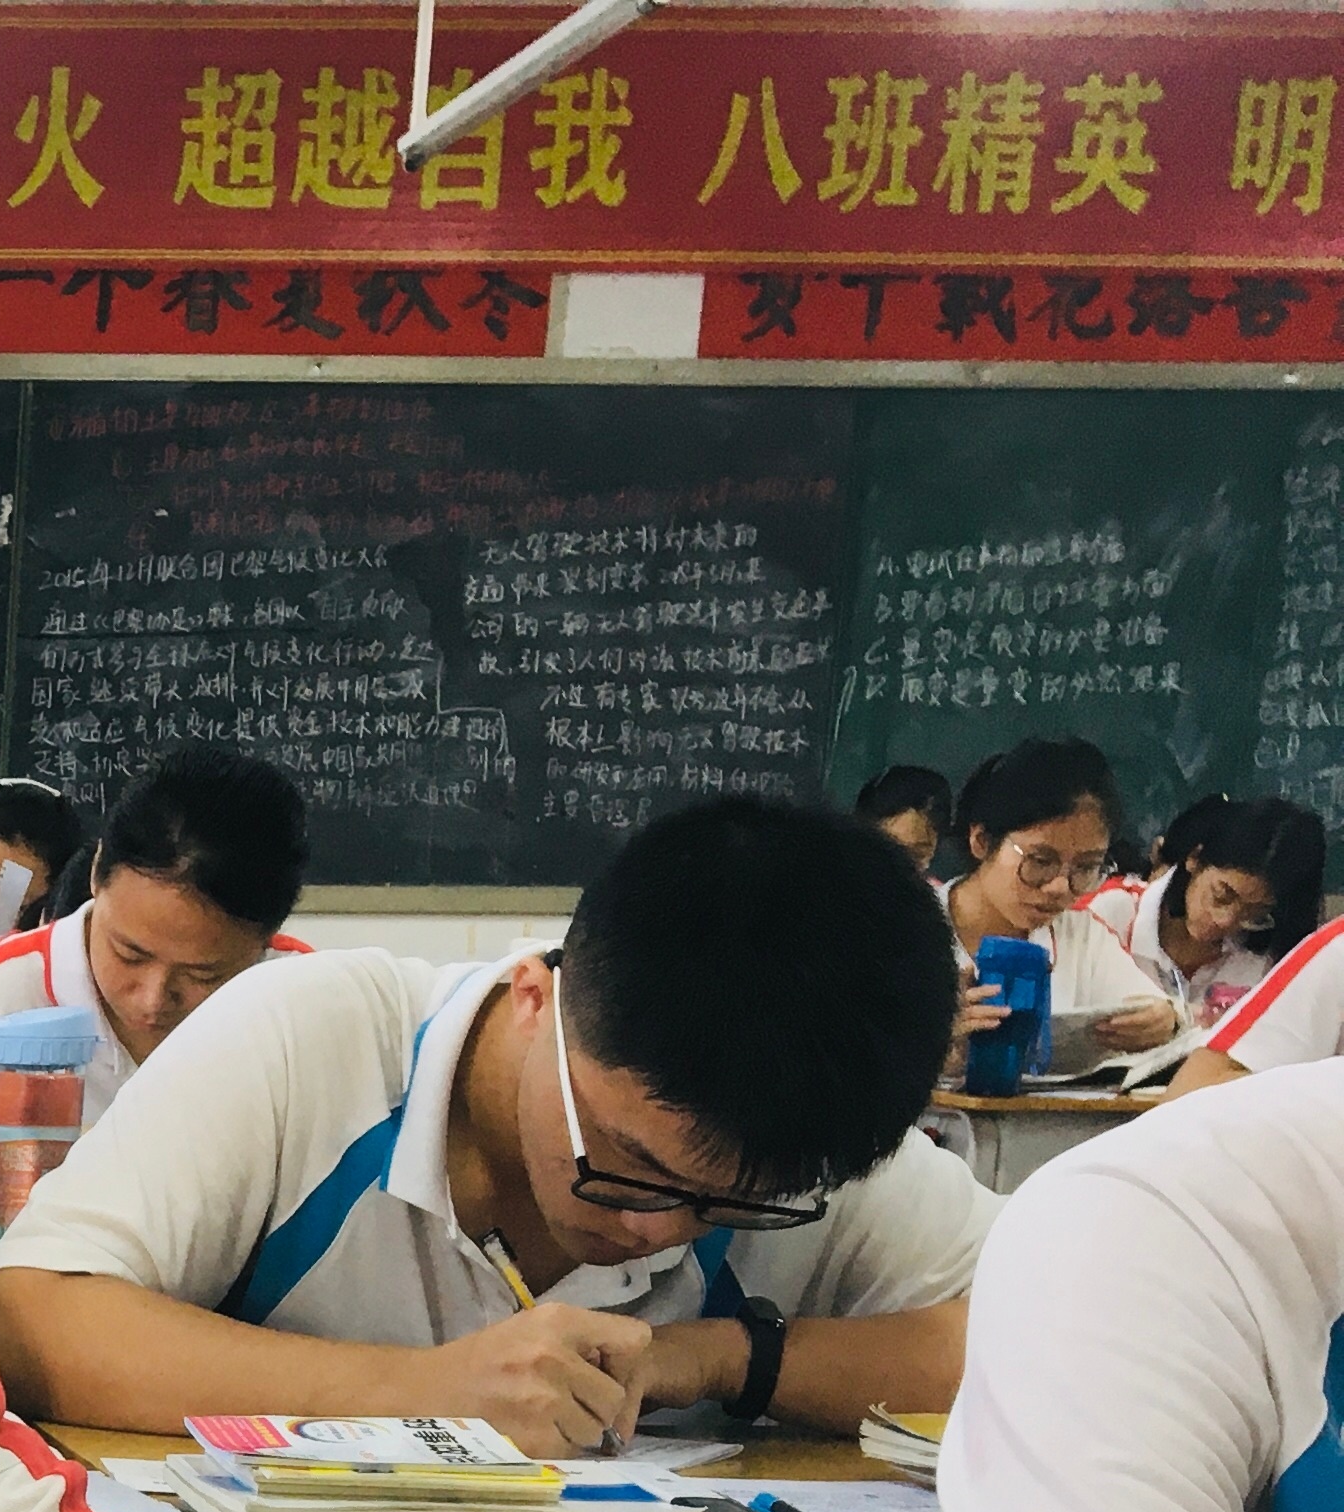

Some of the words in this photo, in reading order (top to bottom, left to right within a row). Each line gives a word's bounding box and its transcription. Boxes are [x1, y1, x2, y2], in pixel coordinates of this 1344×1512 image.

[174, 66, 632, 210] 超越自我
[699, 69, 1163, 215] 八班精英
[1231, 75, 1339, 215] 明
